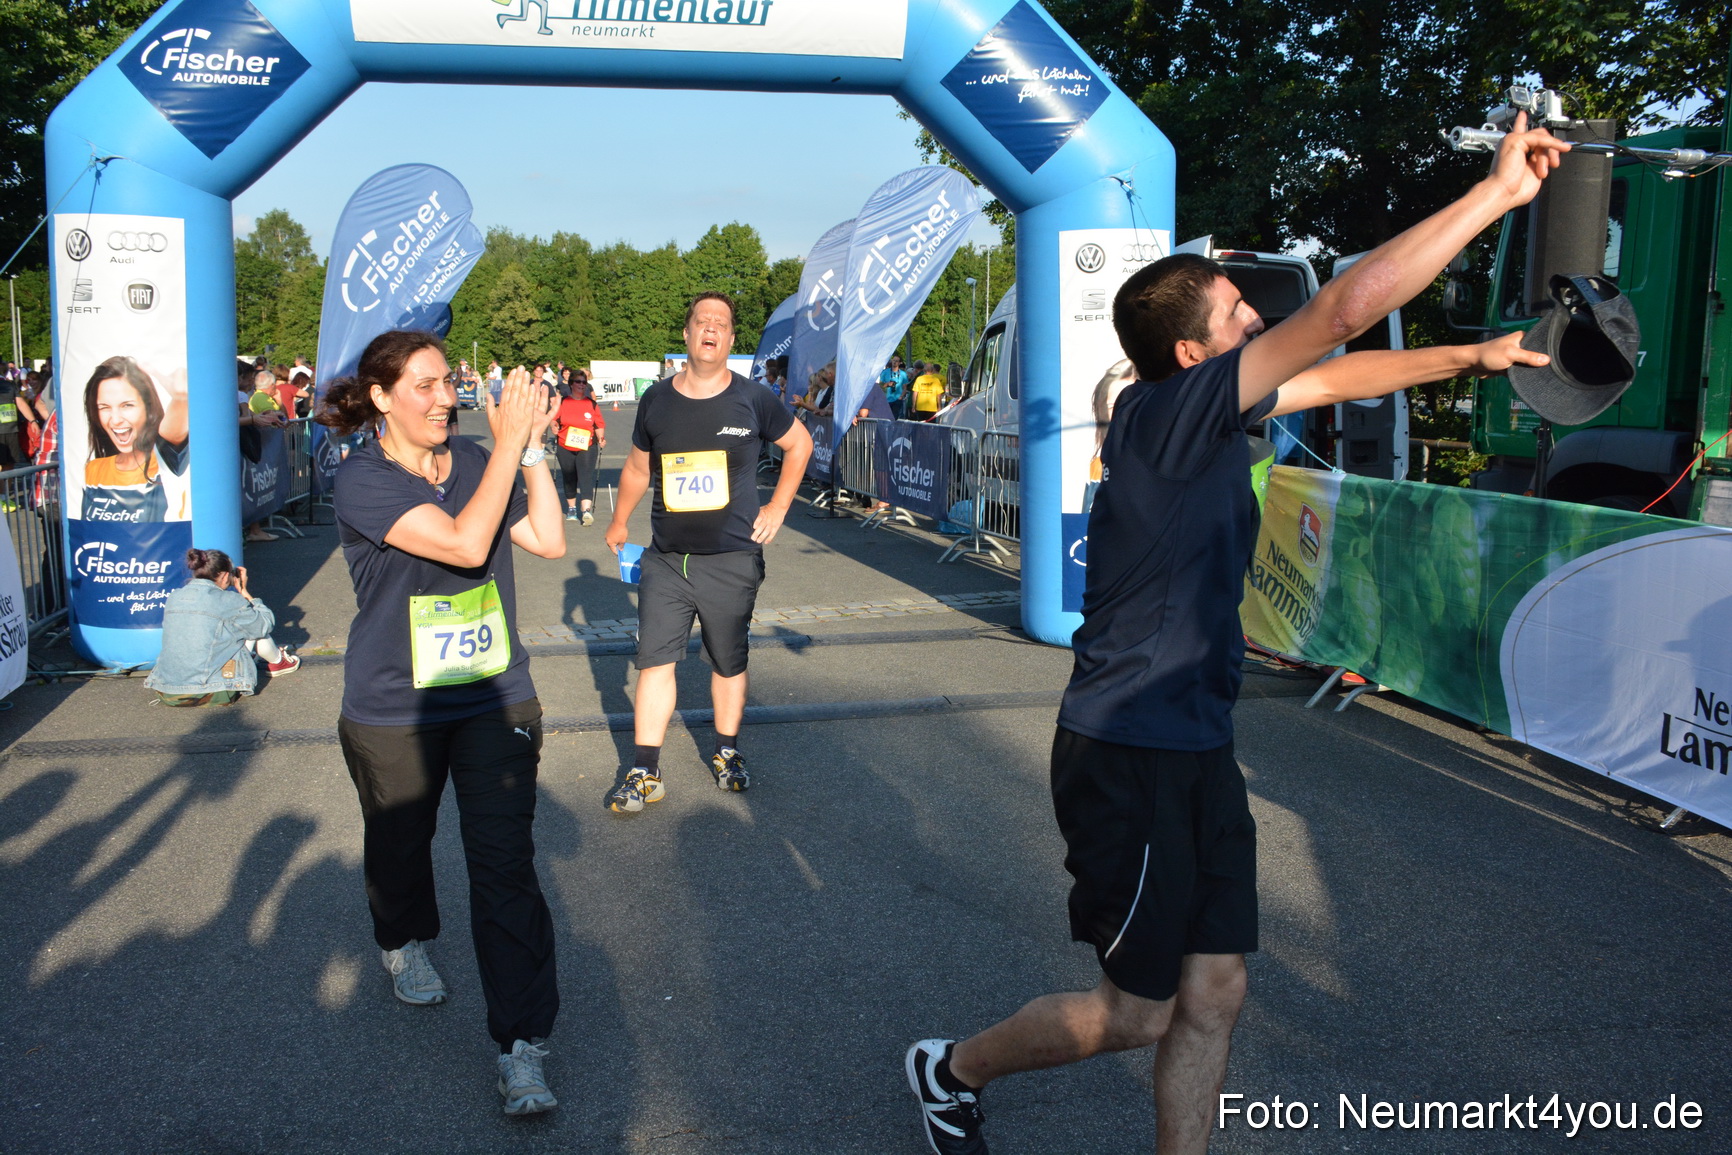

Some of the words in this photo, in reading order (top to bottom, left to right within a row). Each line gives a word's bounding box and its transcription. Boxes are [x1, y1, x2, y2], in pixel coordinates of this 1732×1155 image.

[571, 24, 656, 38] neumarkt
[162, 47, 280, 74] Fischer
[171, 72, 271, 86] AUTOMOBILE
[981, 68, 1010, 85] und
[1060, 84, 1090, 97] mit!
[360, 190, 442, 295] Fischer
[876, 189, 951, 297] Fischer
[110, 256, 135, 264] Audi
[388, 211, 451, 295] AUTOMOBILE
[903, 209, 960, 295] AUTOMOBILE
[421, 248, 469, 314] AUTOMOBILE
[130, 288, 152, 305] FIAT
[67, 306, 101, 314] SEAT
[570, 435, 585, 444] 256
[893, 458, 935, 487] Fischer
[675, 475, 714, 495] 740
[898, 485, 932, 502] AUTOMOBILE
[86, 556, 172, 575] Fischer
[93, 575, 164, 584] AUTOMOBILE
[106, 593, 124, 603] und
[126, 591, 145, 601] das
[146, 588, 175, 600] Läche
[130, 601, 157, 615] fährt
[434, 624, 493, 660] 759
[1693, 686, 1732, 727] Ne
